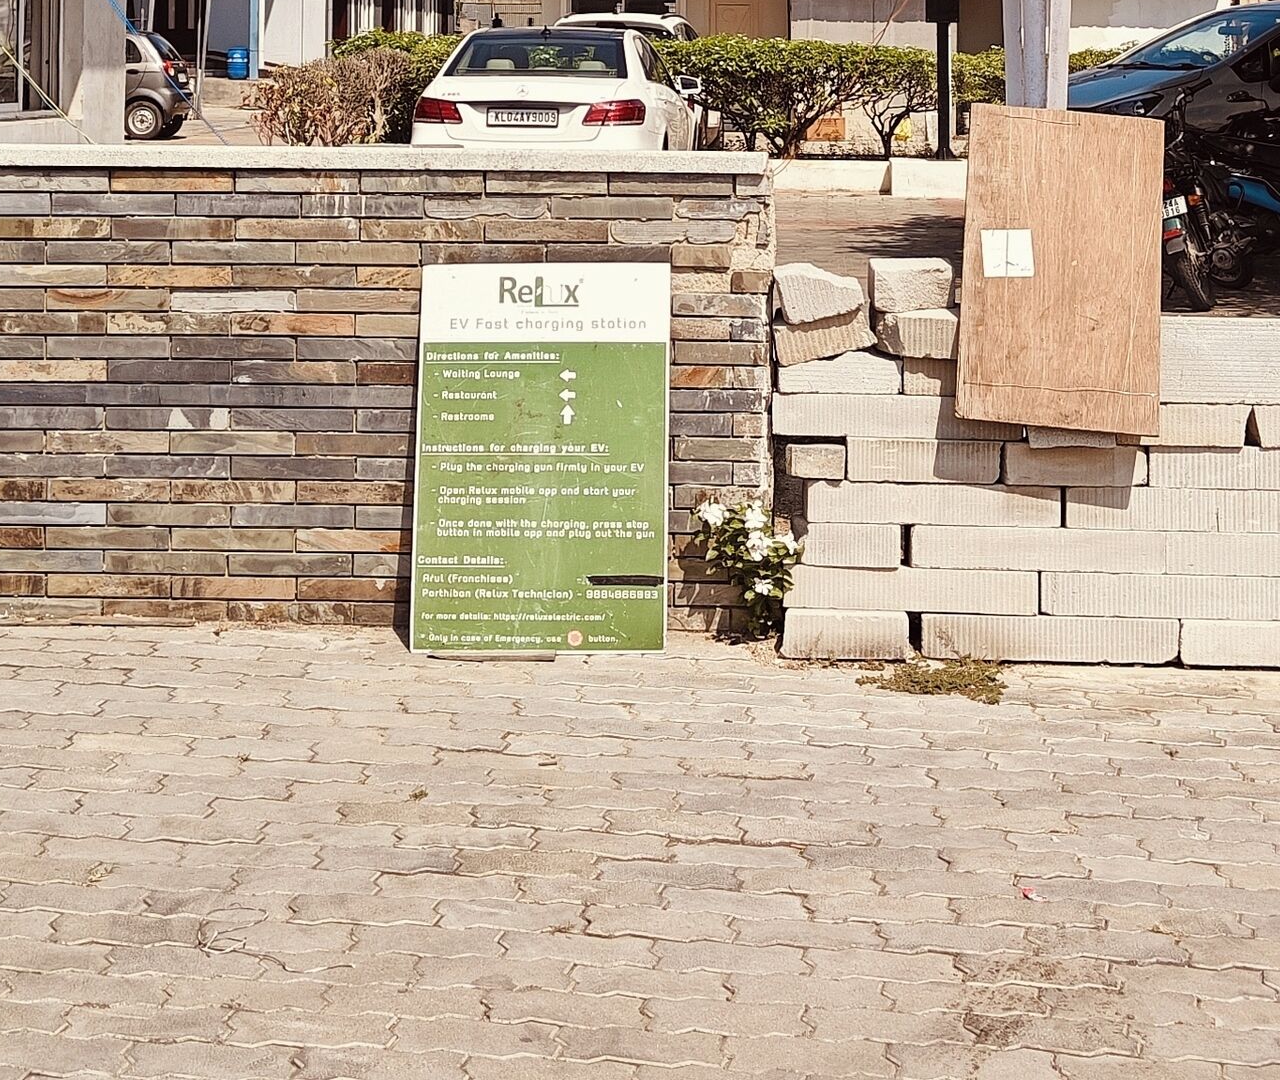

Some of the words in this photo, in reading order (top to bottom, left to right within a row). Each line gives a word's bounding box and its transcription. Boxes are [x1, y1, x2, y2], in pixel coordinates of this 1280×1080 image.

[450, 318, 469, 330] EV
[476, 318, 508, 330] Fast
[516, 318, 583, 331] charging
[591, 318, 647, 329] station
[426, 351, 479, 360] Directions
[484, 351, 499, 360] for
[442, 369, 480, 380] Waiting
[484, 369, 520, 380] Lounge
[441, 390, 498, 400] Restaurant
[440, 412, 495, 421] Restrooms
[421, 443, 484, 452] Instructions
[489, 443, 505, 452] for
[510, 443, 557, 454] charging
[561, 444, 586, 454] your
[440, 462, 463, 473] Plug
[466, 462, 483, 471] the
[486, 462, 531, 473] charging
[534, 464, 553, 473] gun
[556, 462, 588, 473] firmly
[590, 463, 600, 471] in
[604, 464, 627, 473] your
[630, 463, 645, 472] EV
[440, 486, 465, 496] Open
[469, 486, 498, 495] Relux
[501, 486, 535, 495] mobile
[538, 487, 558, 497] app
[561, 486, 579, 495] and
[583, 486, 609, 496] start
[612, 487, 636, 497] your
[438, 495, 482, 505] charging
[485, 495, 526, 504] session
[439, 519, 464, 528] Once
[467, 519, 492, 528] done
[496, 519, 517, 528] with
[520, 519, 537, 528] the
[593, 520, 623, 530] press
[626, 520, 649, 530] stop
[437, 527, 470, 537] button
[473, 528, 482, 536] in
[486, 527, 520, 537] mobile
[524, 529, 543, 538] app
[546, 529, 565, 537] and
[568, 529, 591, 539] plug
[595, 529, 612, 538] out
[615, 529, 632, 538] the
[636, 531, 655, 540] gun
[418, 555, 458, 565] Contact
[423, 573, 445, 583] Arul
[447, 573, 514, 585] (Franchisee)
[421, 588, 471, 598] Parthiban
[475, 588, 508, 599] (Relux
[512, 588, 573, 600] Technician)
[421, 612, 434, 620] for
[428, 634, 449, 643] Only
[483, 634, 493, 642] of
